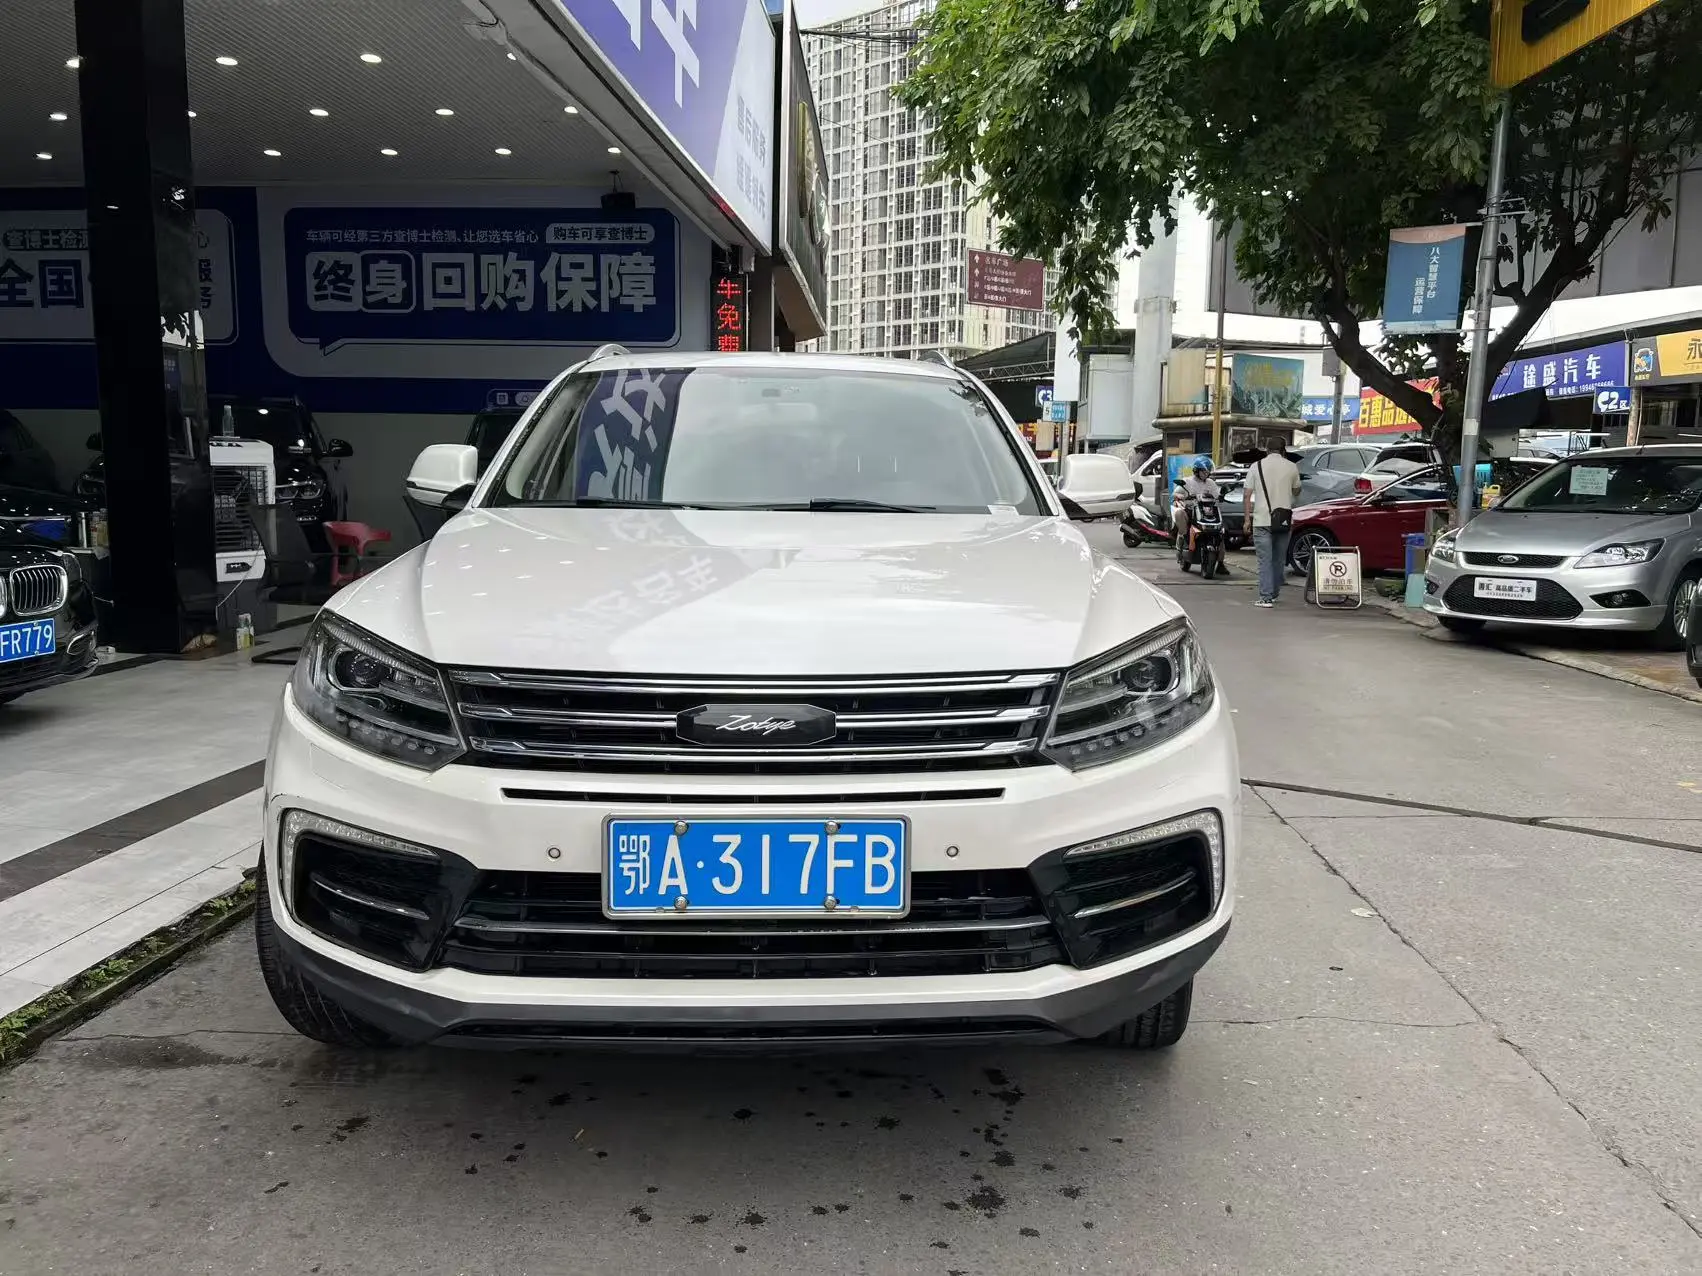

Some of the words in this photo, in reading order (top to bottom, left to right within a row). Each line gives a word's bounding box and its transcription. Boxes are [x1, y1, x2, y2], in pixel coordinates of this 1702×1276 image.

[305, 228, 539, 244] 车辆可经第三方查博士检测、让您选车省心
[552, 226, 648, 241] 购车可享查博士
[309, 252, 657, 312] 终身回购保障
[1426, 246, 1441, 299] 八大智慧平台
[1412, 277, 1426, 315] 运营保障
[1522, 353, 1601, 388] 途盛汽车
[0, 624, 53, 657] FR779
